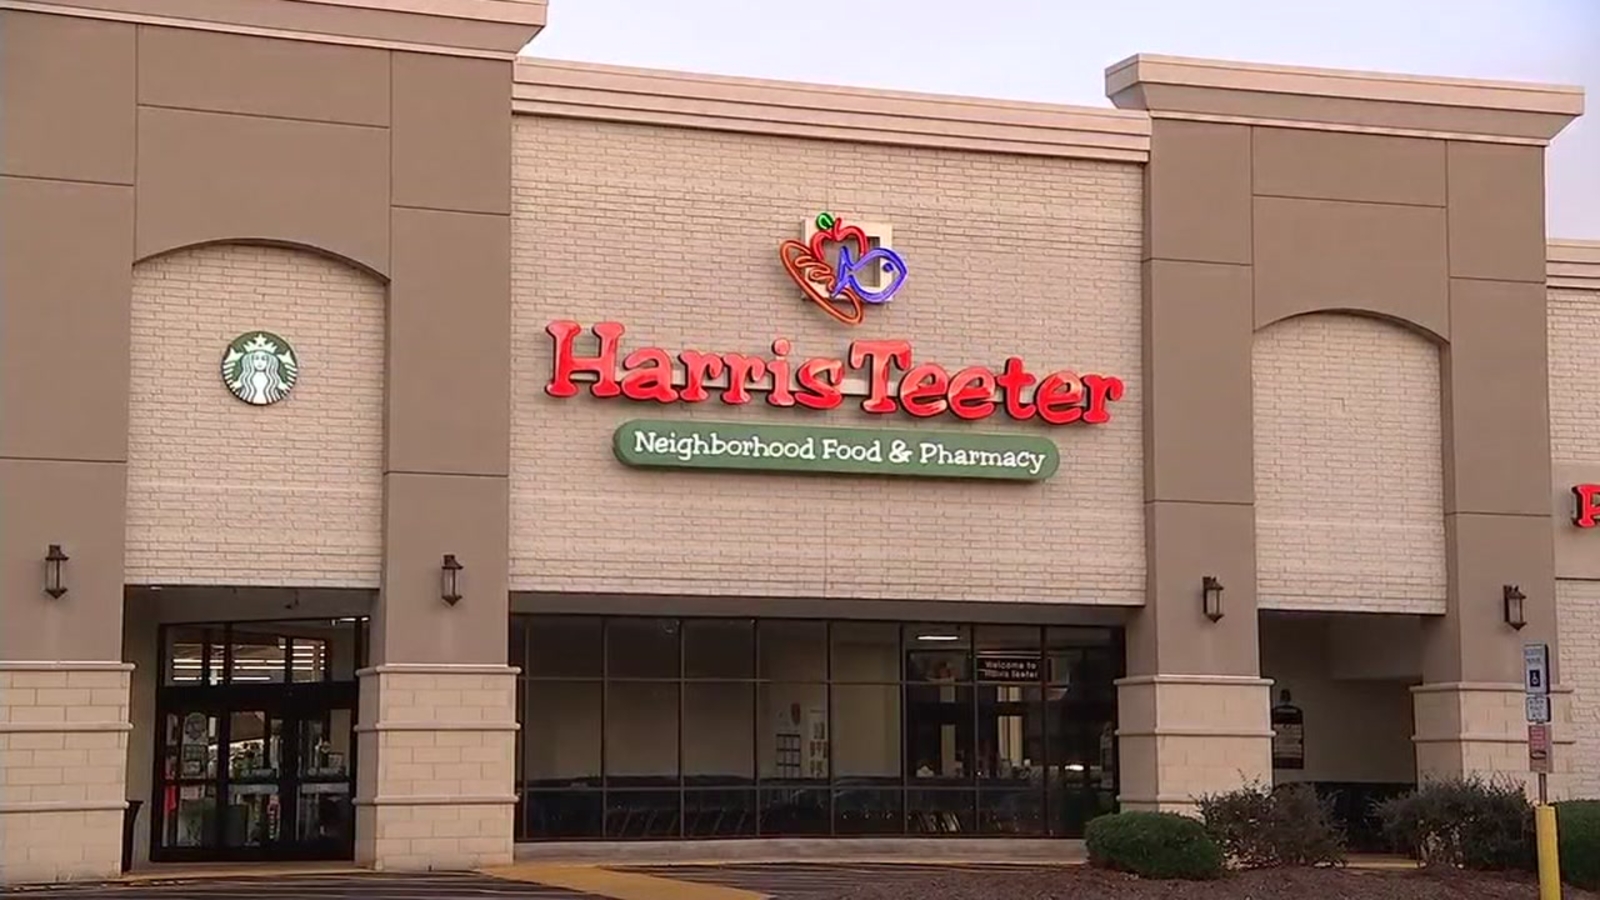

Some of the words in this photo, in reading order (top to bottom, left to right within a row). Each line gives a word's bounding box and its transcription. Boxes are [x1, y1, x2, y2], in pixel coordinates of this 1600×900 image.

[545, 320, 846, 407] Harris
[849, 338, 1125, 425] Teeter
[633, 429, 815, 463] Neighborhood
[822, 438, 882, 464] Food
[888, 440, 914, 464] &
[919, 443, 1046, 475] Pharmacy
[984, 660, 1024, 670] Welcome
[1027, 661, 1037, 670] to
